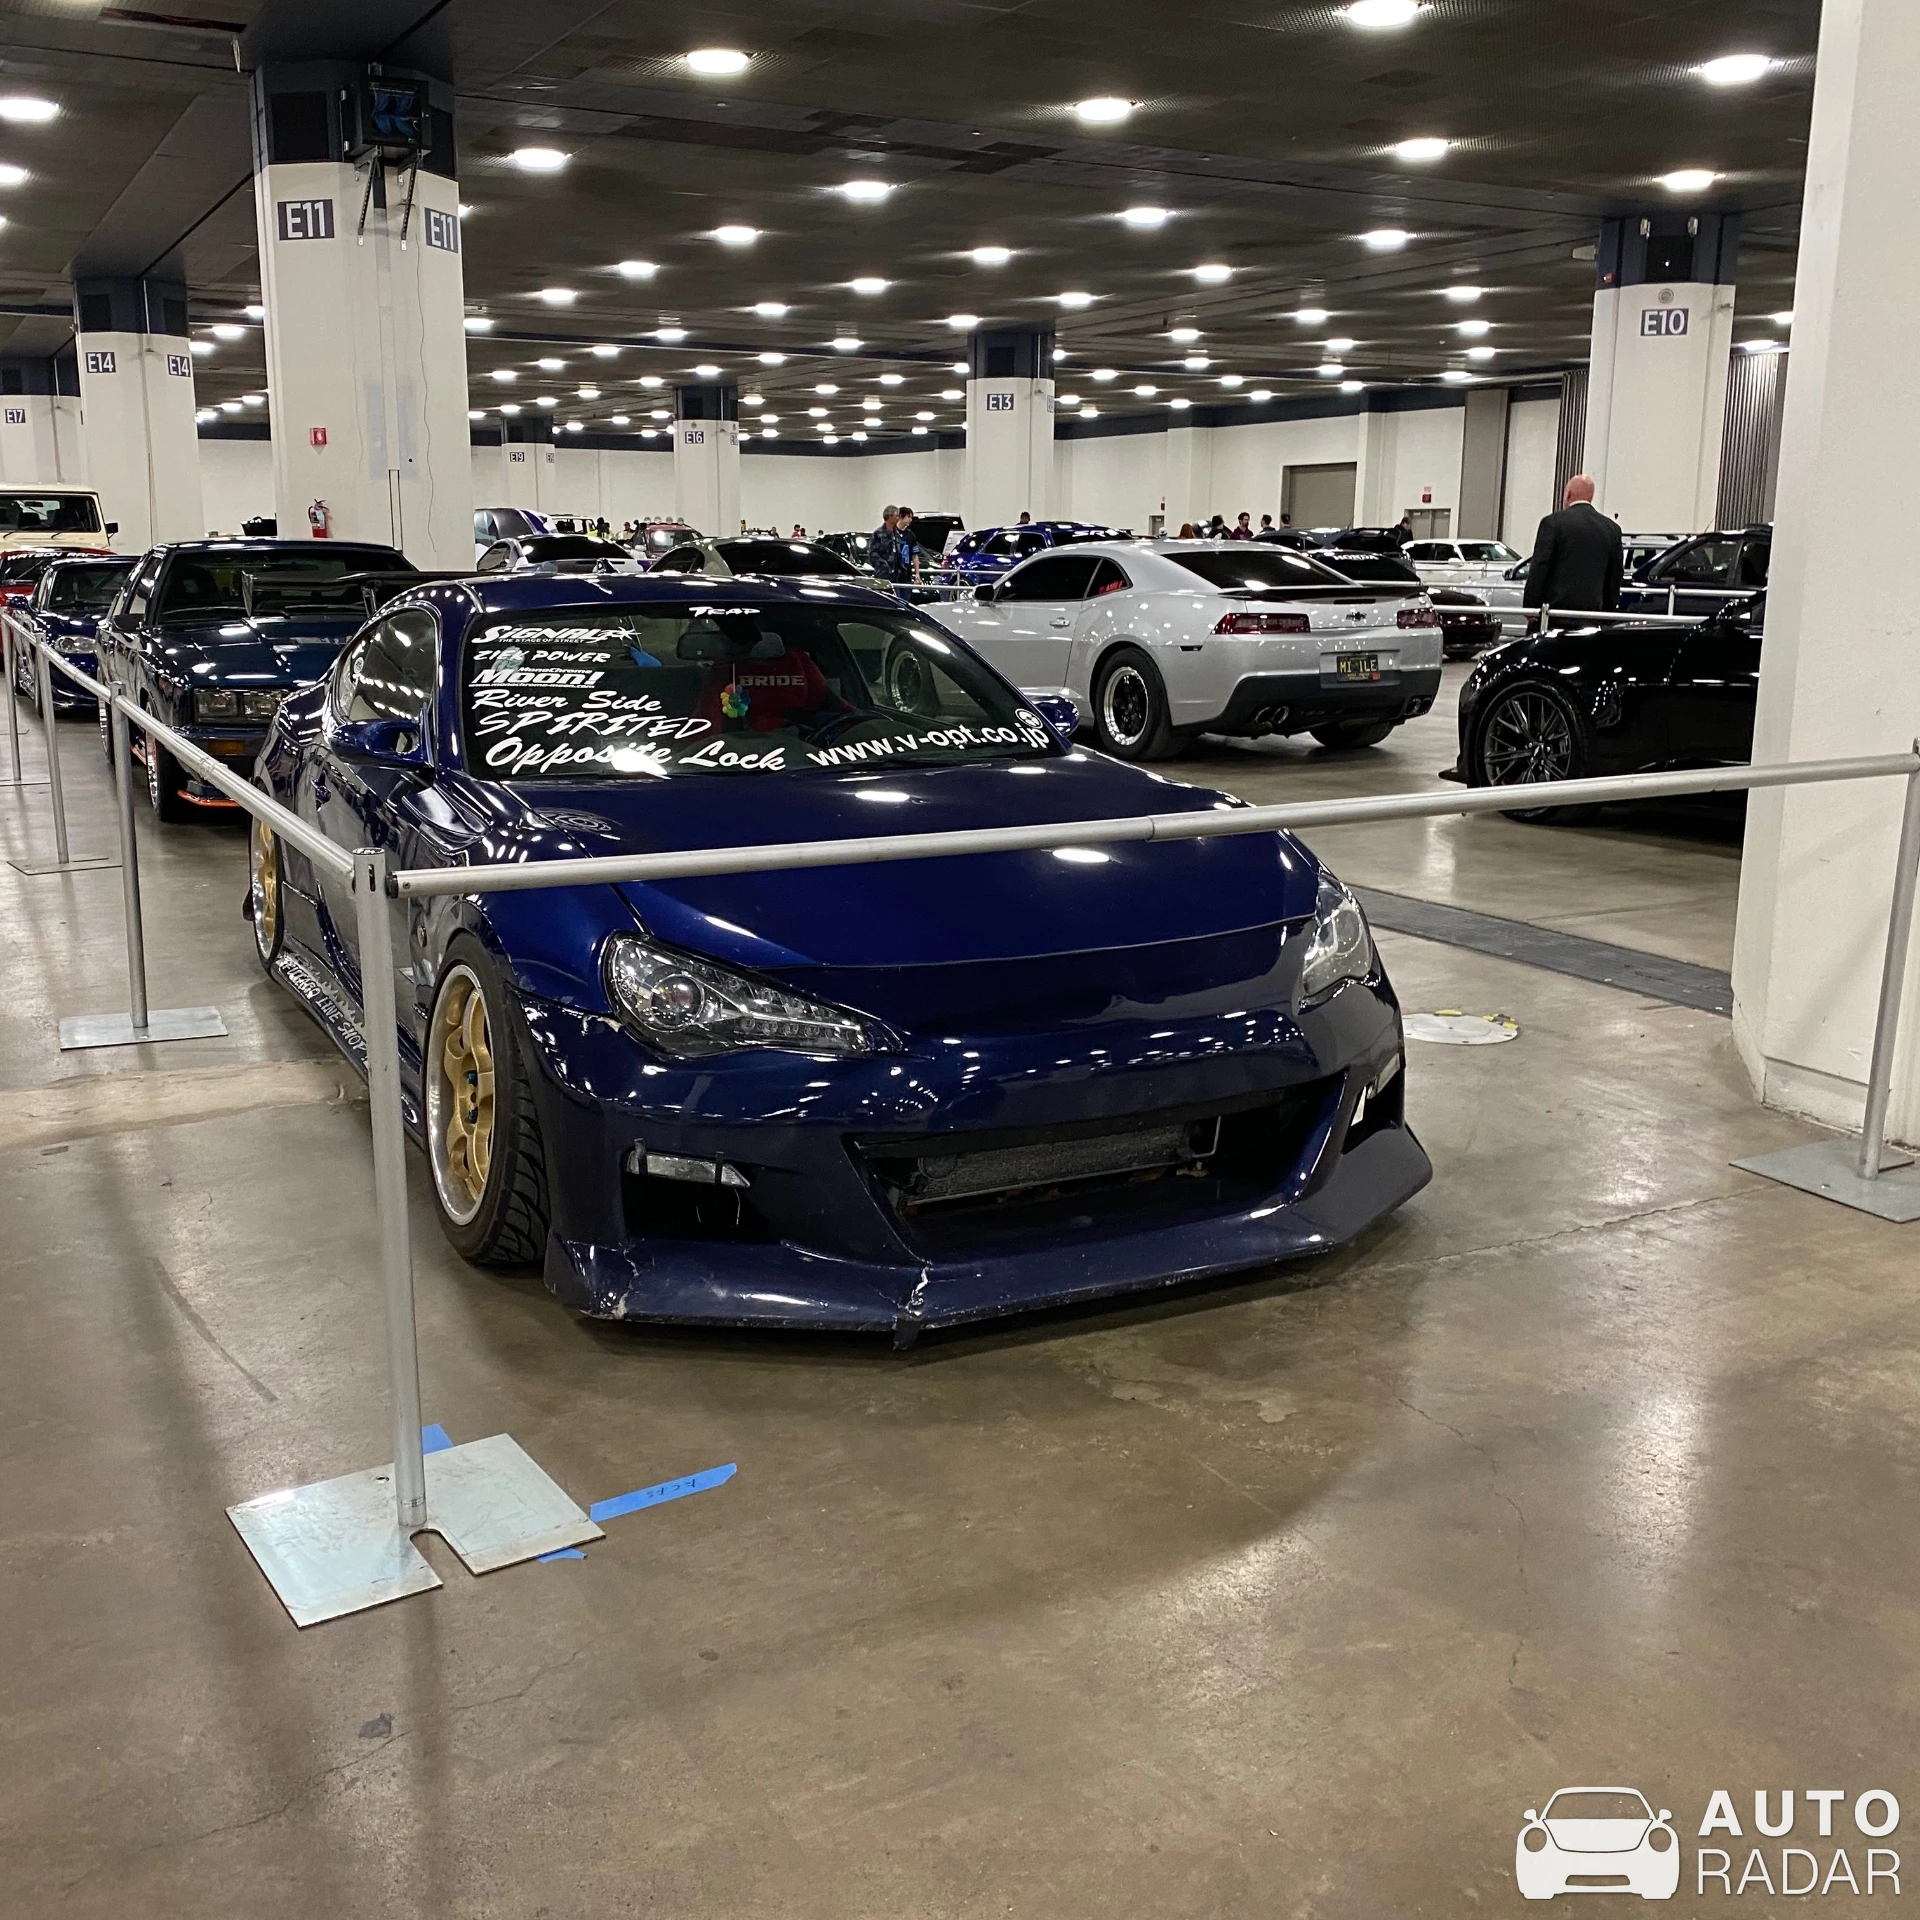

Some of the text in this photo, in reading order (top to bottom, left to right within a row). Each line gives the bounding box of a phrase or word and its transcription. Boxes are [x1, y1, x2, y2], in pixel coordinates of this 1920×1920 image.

[286, 201, 326, 239] E11
[430, 211, 454, 250] E11
[1644, 310, 1685, 335] E10
[88, 353, 113, 372] E14
[169, 356, 189, 376] E14
[989, 394, 1011, 410] E13
[6, 409, 24, 423] E17
[686, 432, 703, 444] E16
[8, 553, 62, 561] WATSON
[531, 650, 611, 662] POWER
[471, 669, 605, 685] Moon!
[739, 675, 805, 687] BRIDE
[472, 690, 662, 711] River Side
[475, 710, 712, 739] SPIRITED
[806, 722, 1050, 767] www.v-opt.co.jp
[678, 740, 786, 771] Lock
[315, 996, 344, 1023] LINE
